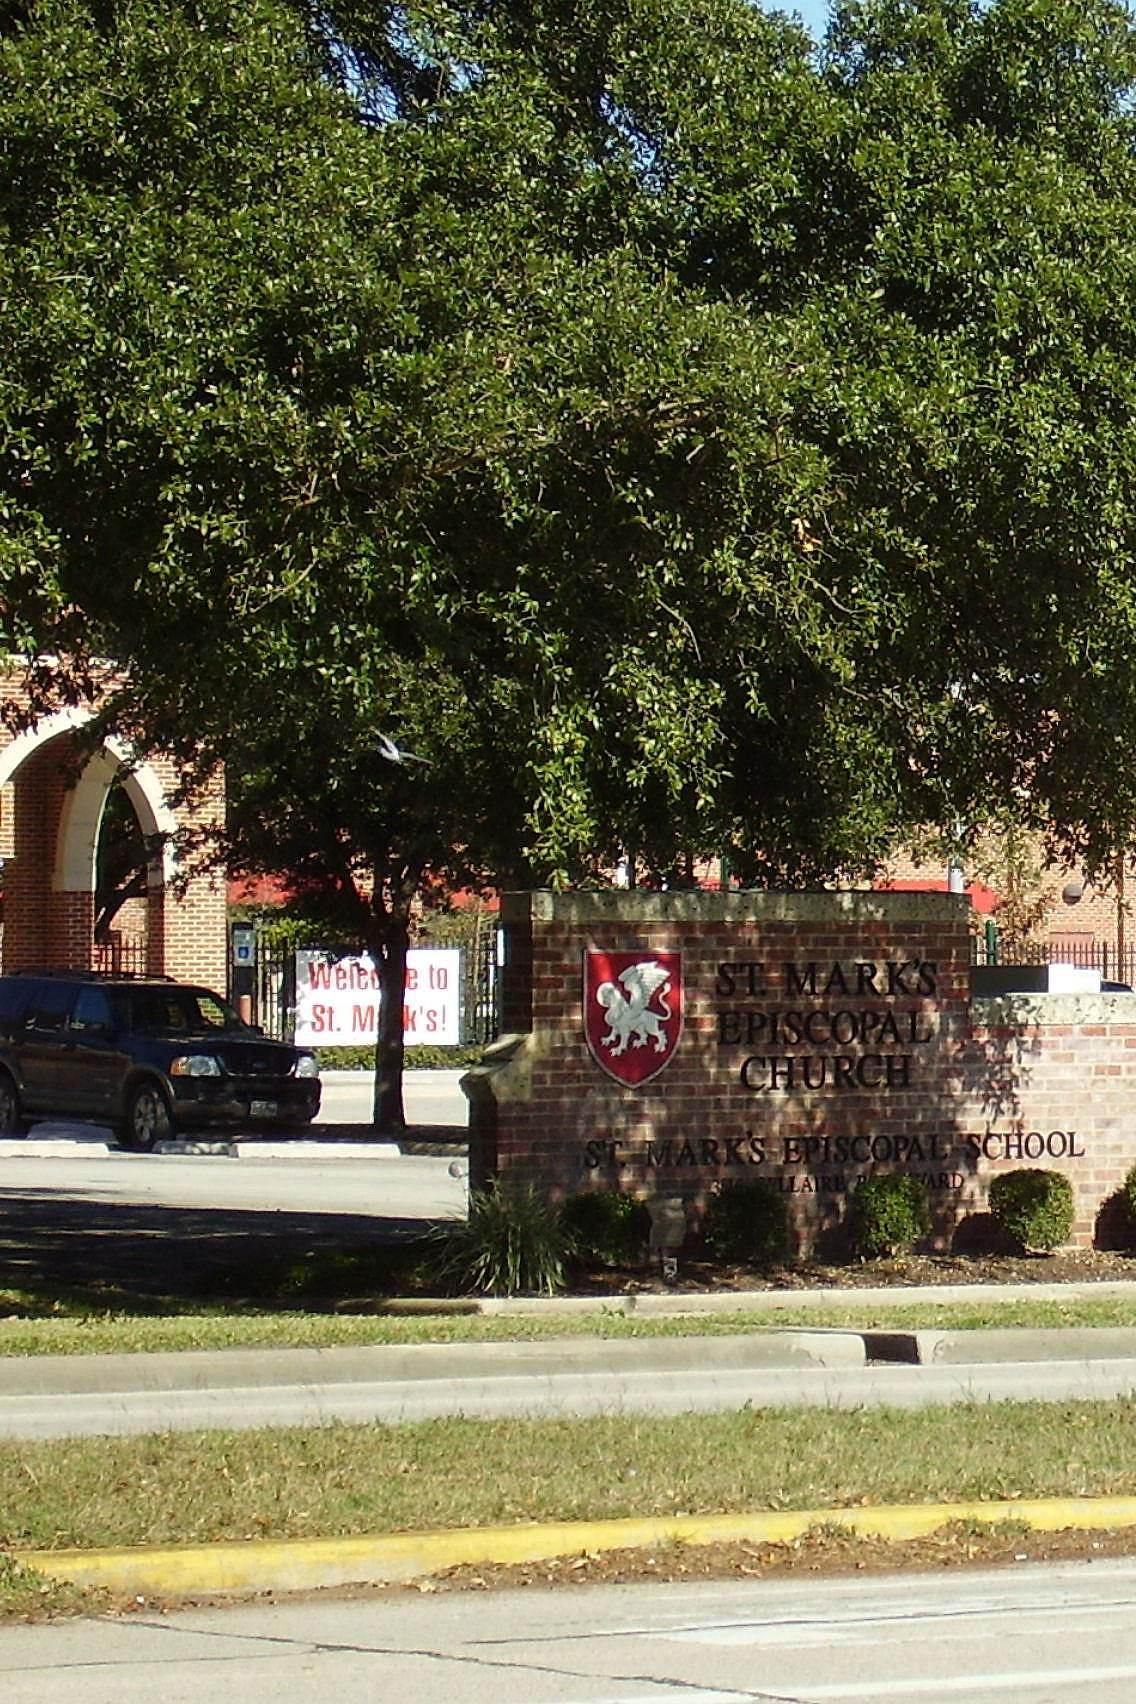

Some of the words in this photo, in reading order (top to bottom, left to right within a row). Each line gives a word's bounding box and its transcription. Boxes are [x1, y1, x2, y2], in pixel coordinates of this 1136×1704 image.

[308, 961, 418, 990] Welcoe
[429, 964, 448, 990] to
[715, 961, 766, 997] ST.
[785, 957, 938, 996] MARK'S
[311, 1004, 342, 1032] St.
[352, 1004, 446, 1032] Mk's!
[716, 1010, 934, 1046] EPISCOPAL
[740, 1054, 913, 1092] CHURCH
[583, 1138, 627, 1169] ST.
[645, 1131, 766, 1167] MARK'S
[783, 1134, 949, 1165] EPISCOPAL
[966, 1130, 1086, 1161] SCHOOL
